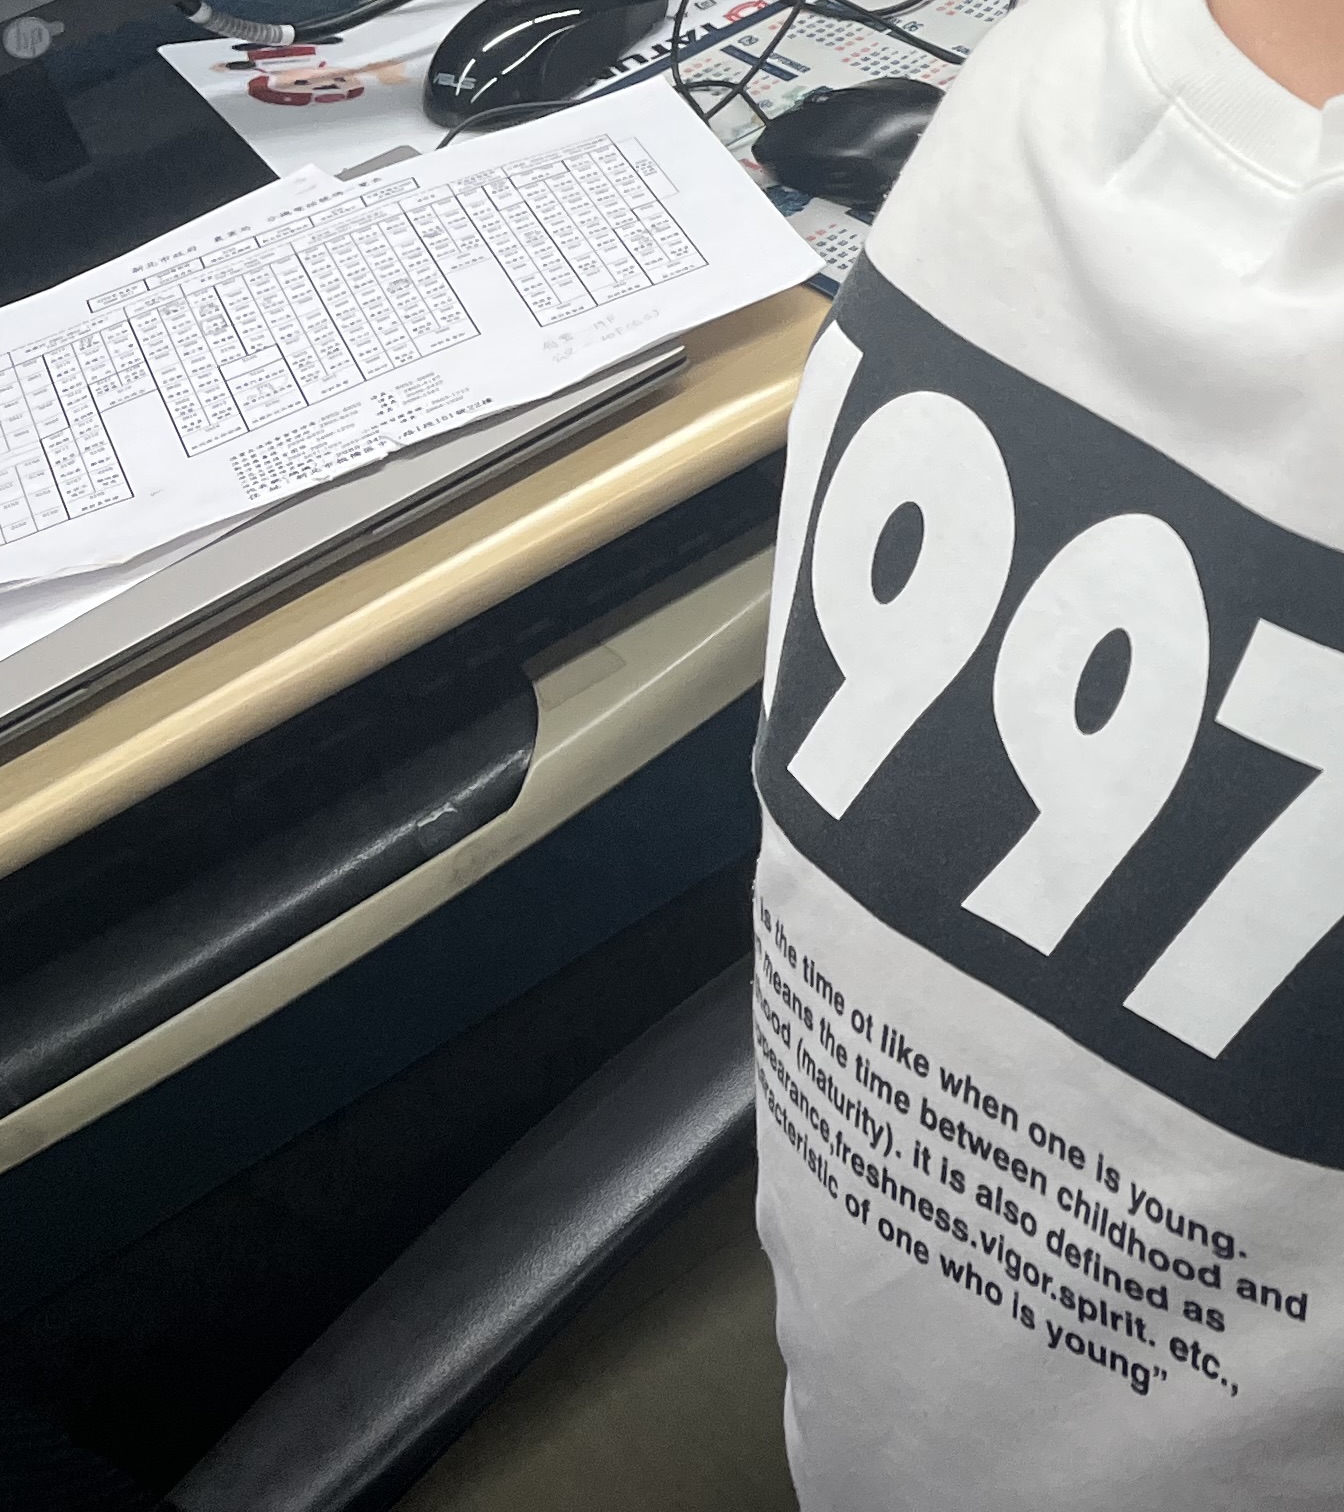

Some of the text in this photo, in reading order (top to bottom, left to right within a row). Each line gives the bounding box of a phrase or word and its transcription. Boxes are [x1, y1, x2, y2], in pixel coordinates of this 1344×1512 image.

[763, 957, 813, 1030] means
[819, 1018, 847, 1069] the
[856, 1060, 910, 1114] time
[920, 1099, 1049, 1195] between
[1057, 1184, 1222, 1290] childhood
[1236, 1276, 1308, 1322] and
[775, 919, 798, 969] the
[803, 957, 845, 1016] time
[880, 1025, 931, 1078] like
[940, 1065, 1018, 1131] when
[1029, 1120, 1086, 1170] one
[1097, 1154, 1120, 1192] is
[1128, 1183, 1248, 1261] young.
[845, 1194, 871, 1227] of
[879, 1220, 931, 1264] one
[940, 1250, 1003, 1306] who
[1012, 1292, 1036, 1330] is
[913, 1140, 933, 1170] it
[941, 1156, 965, 1194] is
[976, 1183, 1037, 1236] also
[1046, 1227, 1170, 1311] defined
[1182, 1297, 1227, 1332] as
[1170, 1337, 1239, 1395] etc.,
